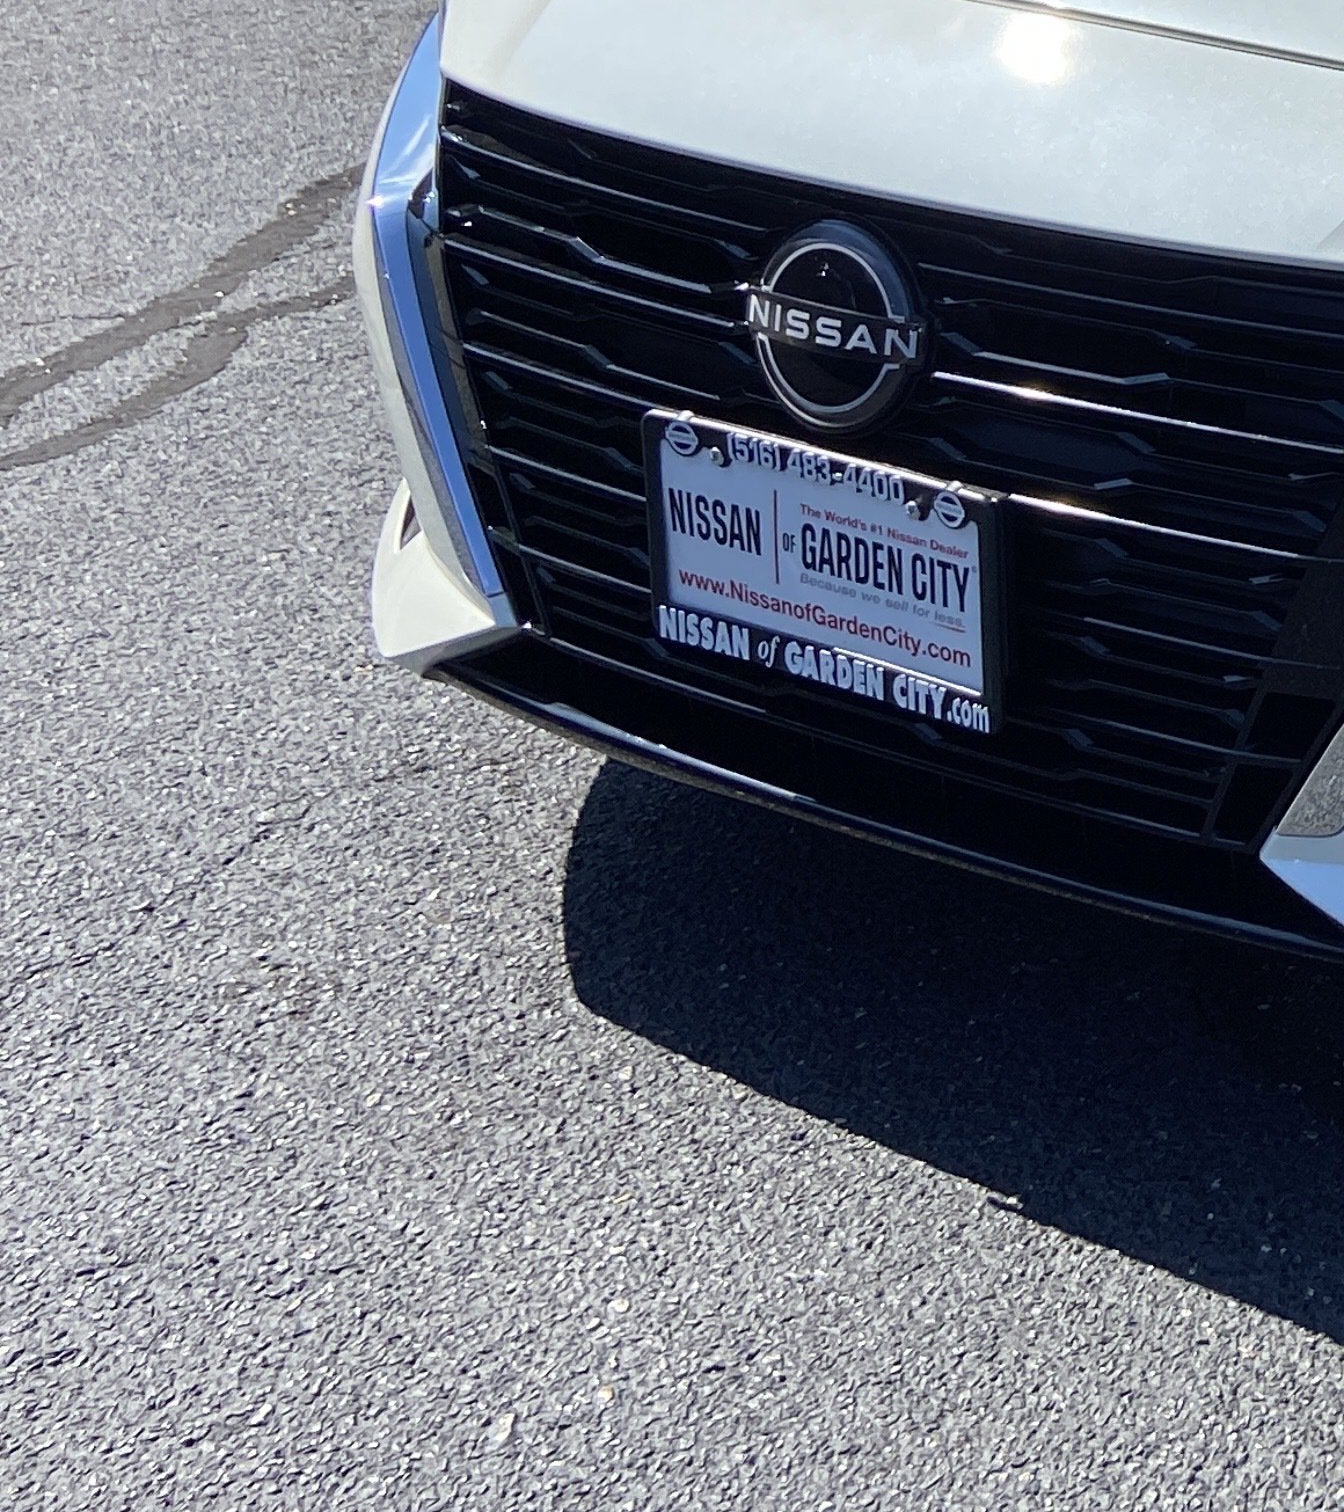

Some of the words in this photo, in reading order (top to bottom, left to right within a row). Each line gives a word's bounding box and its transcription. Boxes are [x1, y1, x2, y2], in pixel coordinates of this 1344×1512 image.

[749, 294, 918, 358] NISSAN
[727, 432, 781, 473] (516)
[787, 448, 906, 506] 483-4400
[668, 488, 761, 556] NISSAN
[782, 532, 796, 553] OF
[801, 523, 903, 595] GARDEN
[911, 553, 970, 612] CITY
[800, 503, 821, 520] The
[825, 510, 867, 531] World's
[870, 521, 883, 536] #1
[887, 528, 928, 547] Nissan
[930, 539, 969, 559] Dealer
[679, 569, 972, 667] www.NissanofGardenCity.com
[800, 573, 857, 598] Because
[861, 591, 880, 605] we
[885, 597, 909, 613] sell
[912, 604, 930, 619] for
[658, 605, 750, 663] NISSAN
[757, 634, 780, 668] of
[784, 641, 884, 701] GARDEN
